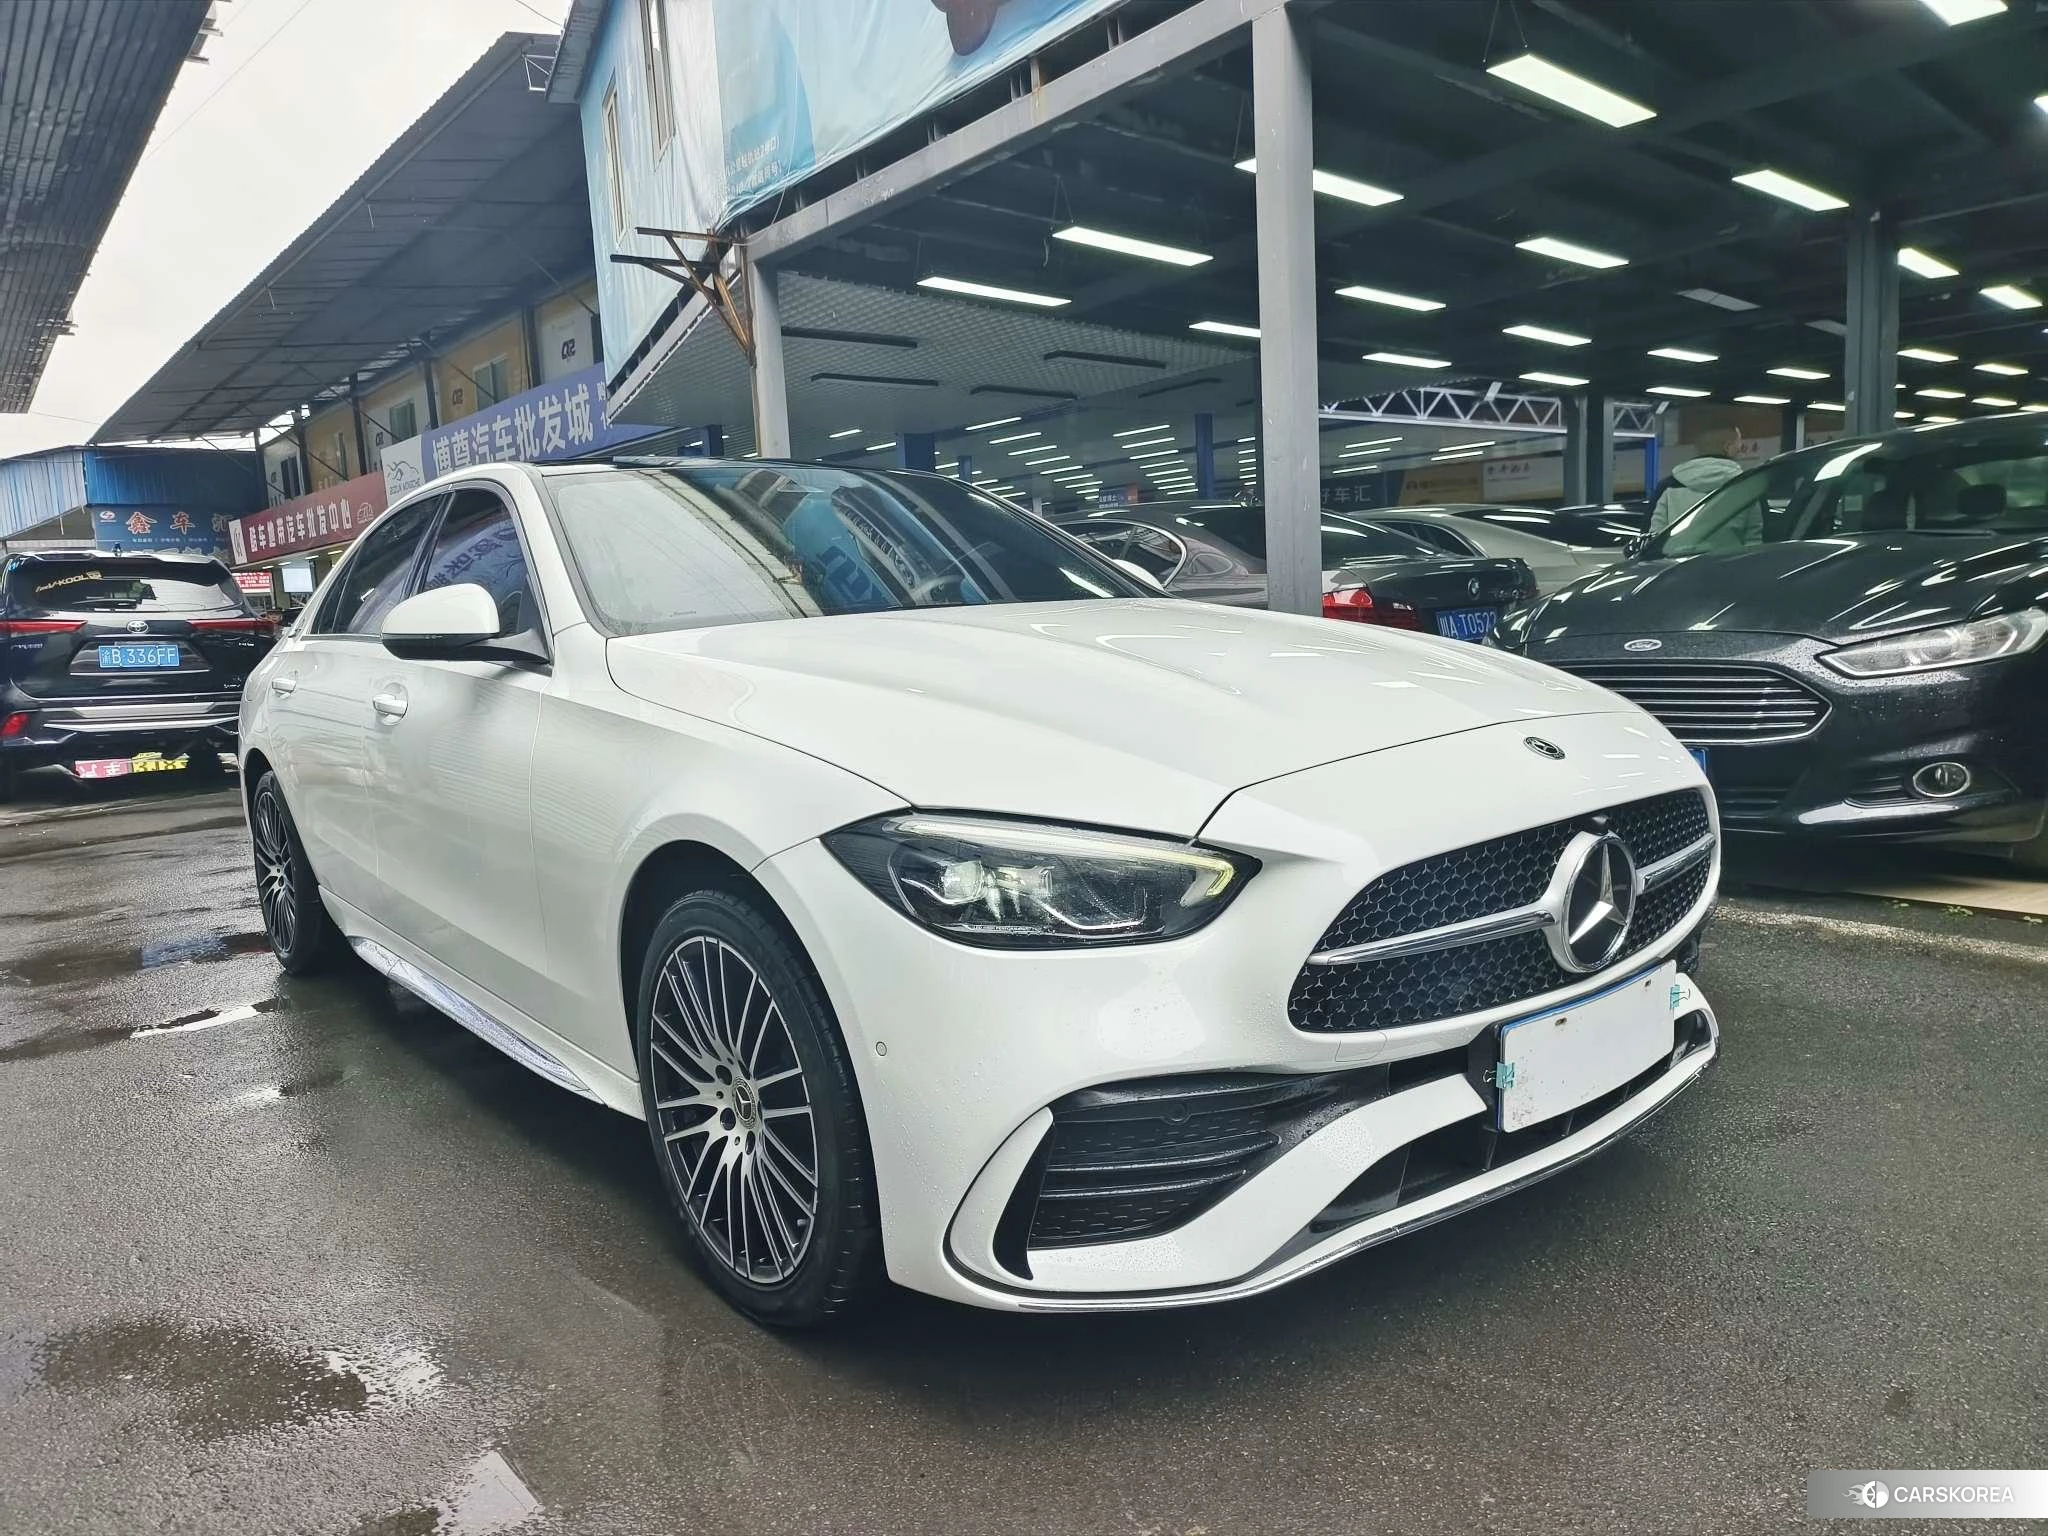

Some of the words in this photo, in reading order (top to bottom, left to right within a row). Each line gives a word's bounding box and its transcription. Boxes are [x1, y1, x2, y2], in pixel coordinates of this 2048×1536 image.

[432, 383, 594, 477] 博尊汽车批发城
